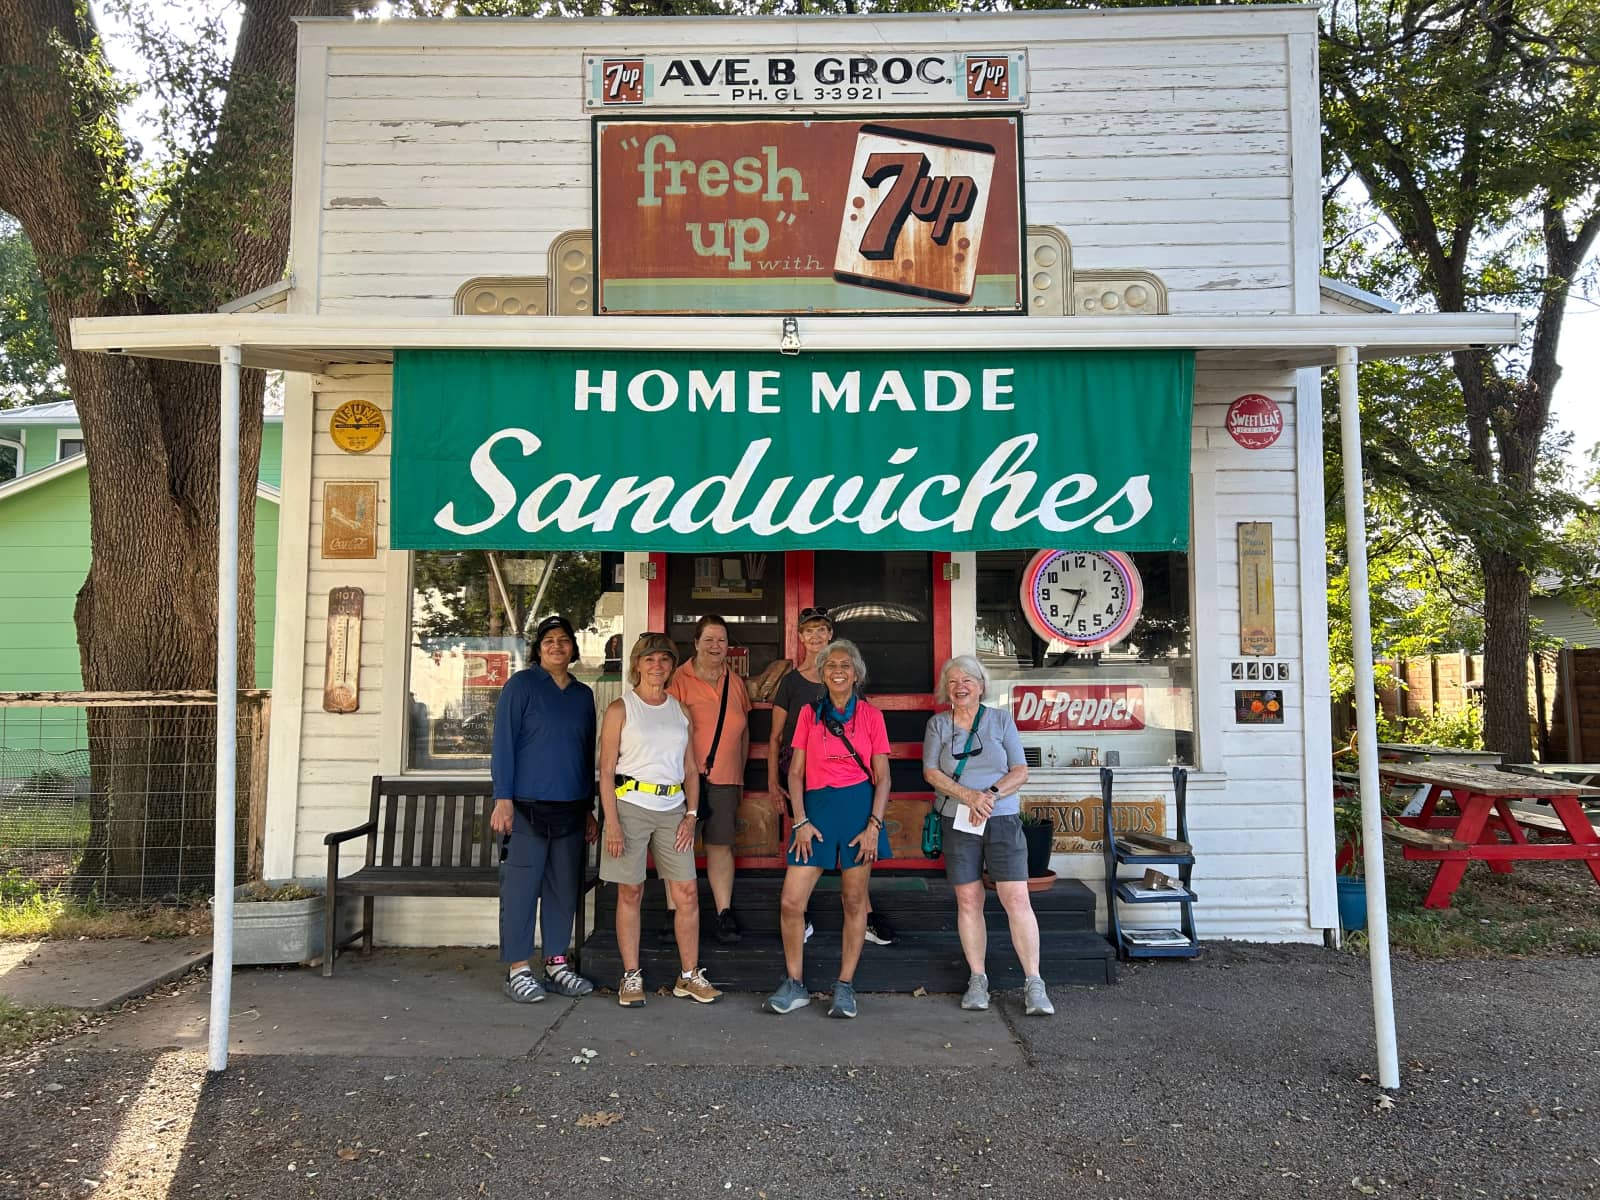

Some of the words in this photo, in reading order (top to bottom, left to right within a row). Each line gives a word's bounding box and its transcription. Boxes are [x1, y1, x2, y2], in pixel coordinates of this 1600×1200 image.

[659, 58, 759, 87] AVE.
[768, 58, 796, 86] B
[814, 57, 953, 85] GROC.
[970, 60, 1005, 96] 7up
[606, 63, 641, 99] 7up
[732, 88, 768, 101] PH.
[775, 88, 804, 101] GL
[814, 87, 882, 100] 3-3921
[858, 152, 978, 261] 7up
[757, 255, 825, 271] with
[574, 369, 781, 413] HOME
[811, 368, 1015, 413] MADE
[433, 427, 1153, 536] Sandwiches
[1061, 559, 1070, 572] 11
[1074, 556, 1086, 569] 12
[1092, 559, 1097, 571] 1
[1047, 571, 1059, 584] 10
[1102, 570, 1112, 583] 2
[1041, 588, 1051, 601] 9
[1110, 586, 1120, 599] 3
[1049, 604, 1059, 617] 8
[1105, 603, 1115, 616] 4
[1062, 614, 1071, 627] 7
[1078, 619, 1087, 632] 6
[1093, 613, 1102, 626] 5
[1231, 663, 1290, 680] 4403
[1017, 692, 1048, 721] Dr
[1050, 692, 1140, 727] Pepper
[1092, 806, 1157, 833] FEDS
